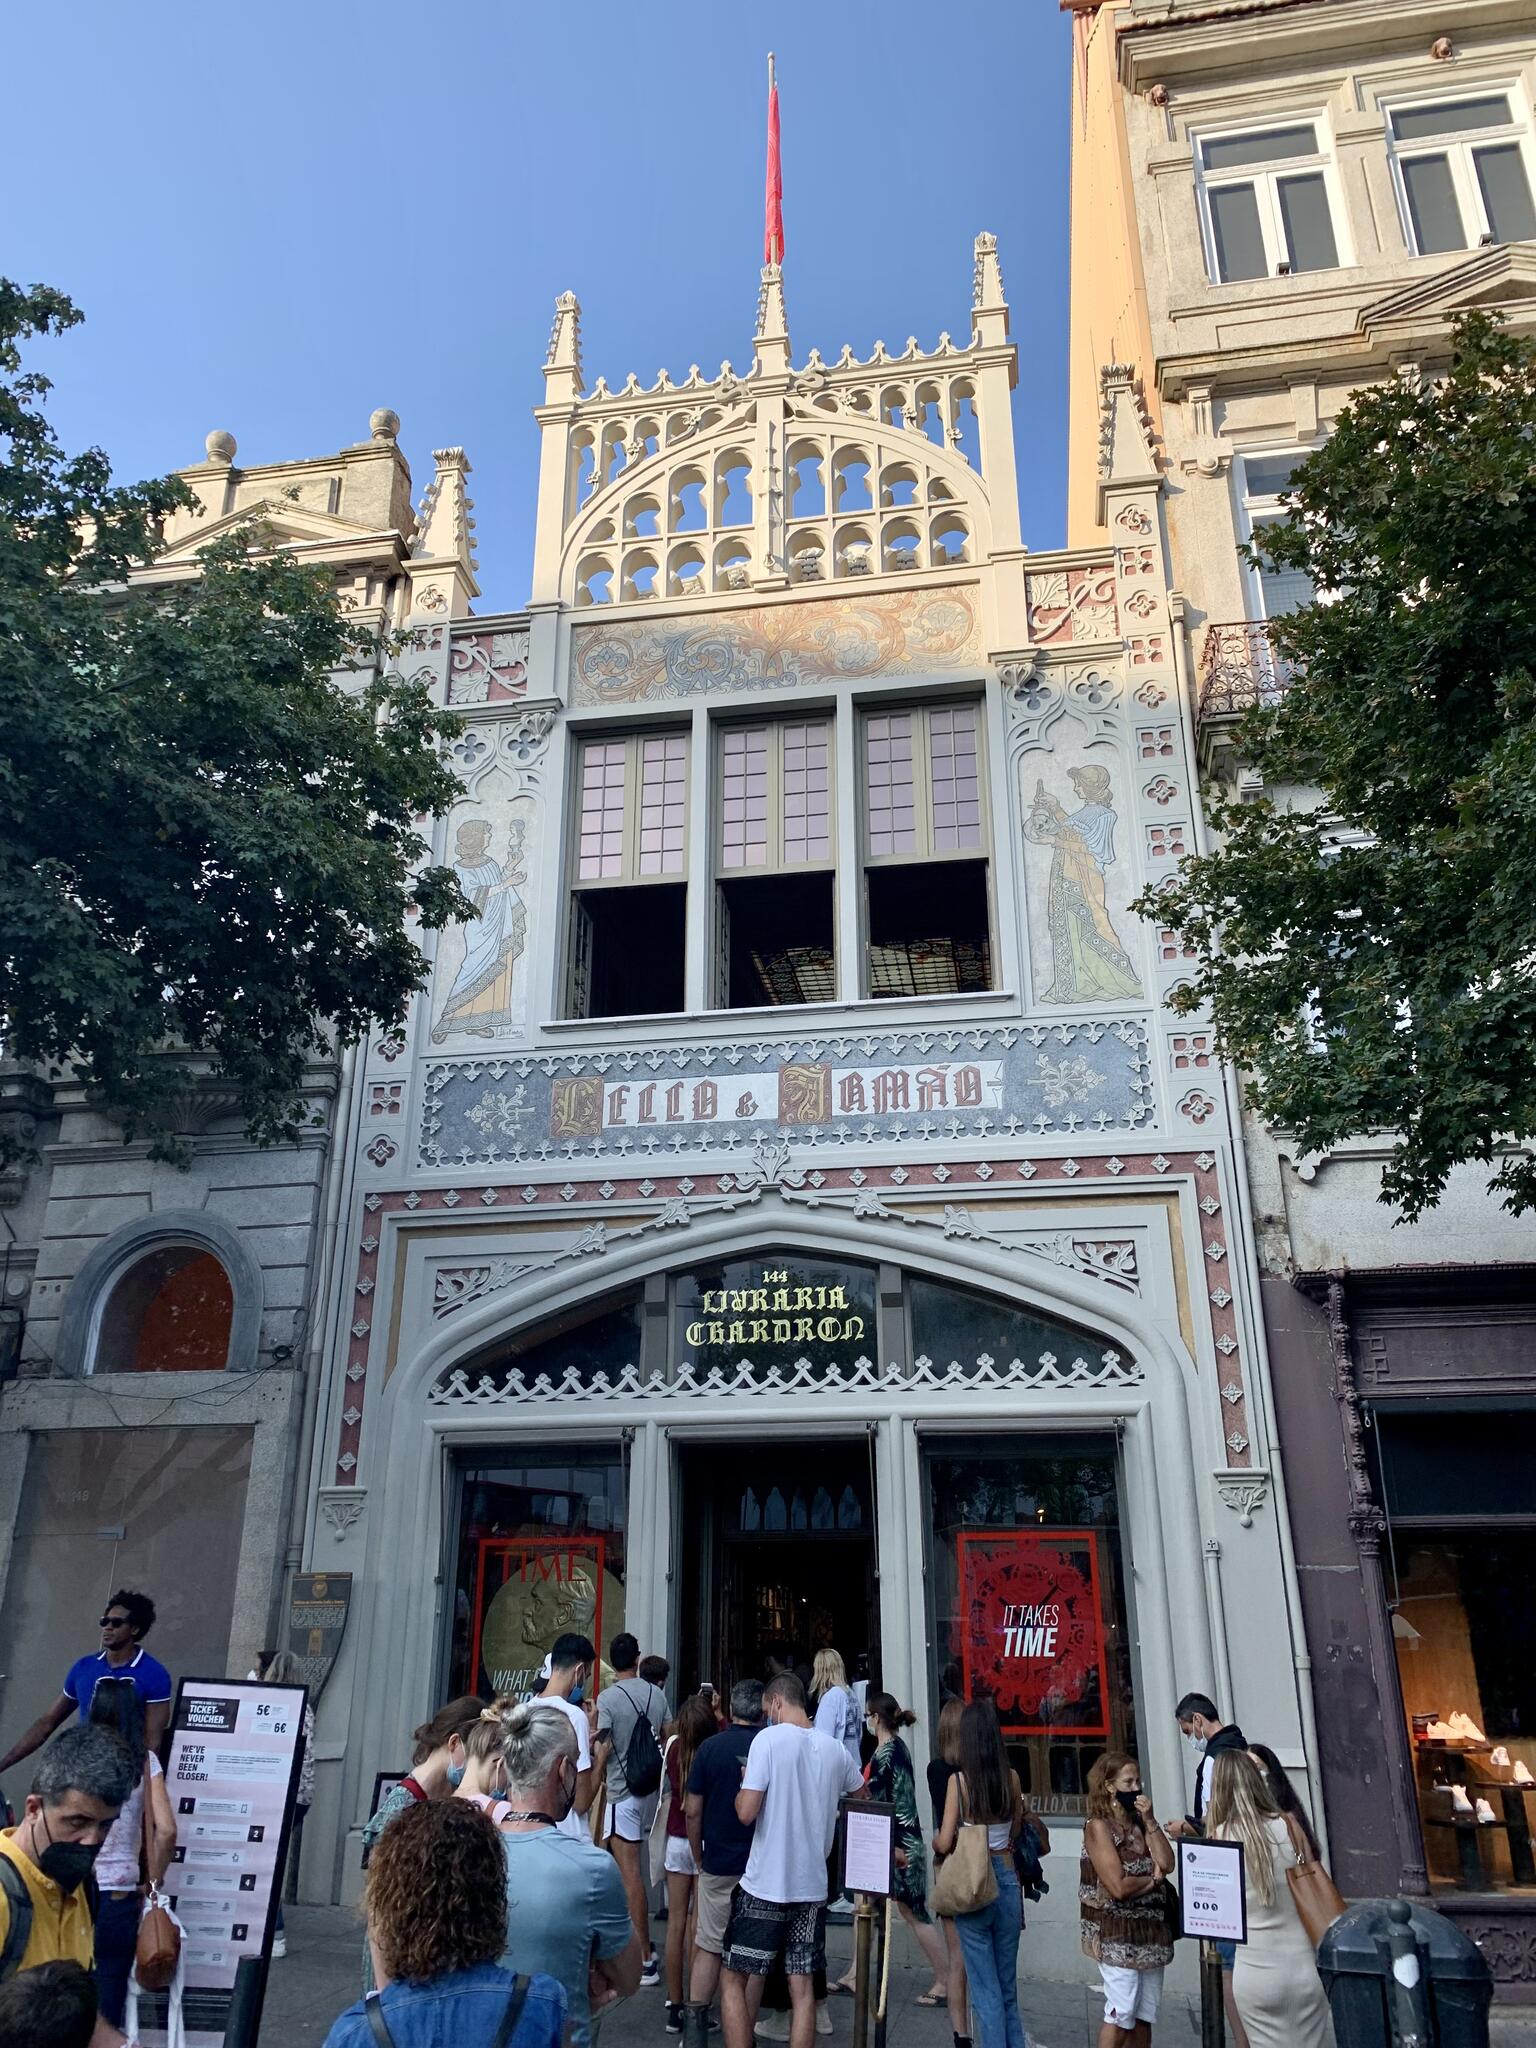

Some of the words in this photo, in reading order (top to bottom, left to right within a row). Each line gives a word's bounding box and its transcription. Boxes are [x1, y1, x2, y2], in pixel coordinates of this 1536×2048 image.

[552, 1078, 718, 1136] LELLO
[735, 1090, 760, 1118] &
[762, 1270, 788, 1283] 144
[702, 1285, 849, 1314] LIVRARIA
[686, 1316, 865, 1347] CHARDRON
[495, 1551, 587, 1584] TIME
[1003, 1604, 1017, 1627] IT
[1019, 1604, 1060, 1627] TAKES
[1003, 1627, 1059, 1658] TIME
[190, 1704, 219, 1715] TICKET-
[256, 1704, 271, 1717] 5€
[188, 1713, 225, 1725] VOUCHER
[273, 1722, 287, 1734] 6€
[182, 1744, 206, 1755] WE'VE
[180, 1754, 205, 1764] NEVER
[178, 1762, 198, 1772] BEEN
[176, 1771, 209, 1782] CLOSER!
[1030, 1795, 1059, 1814] ELLO
